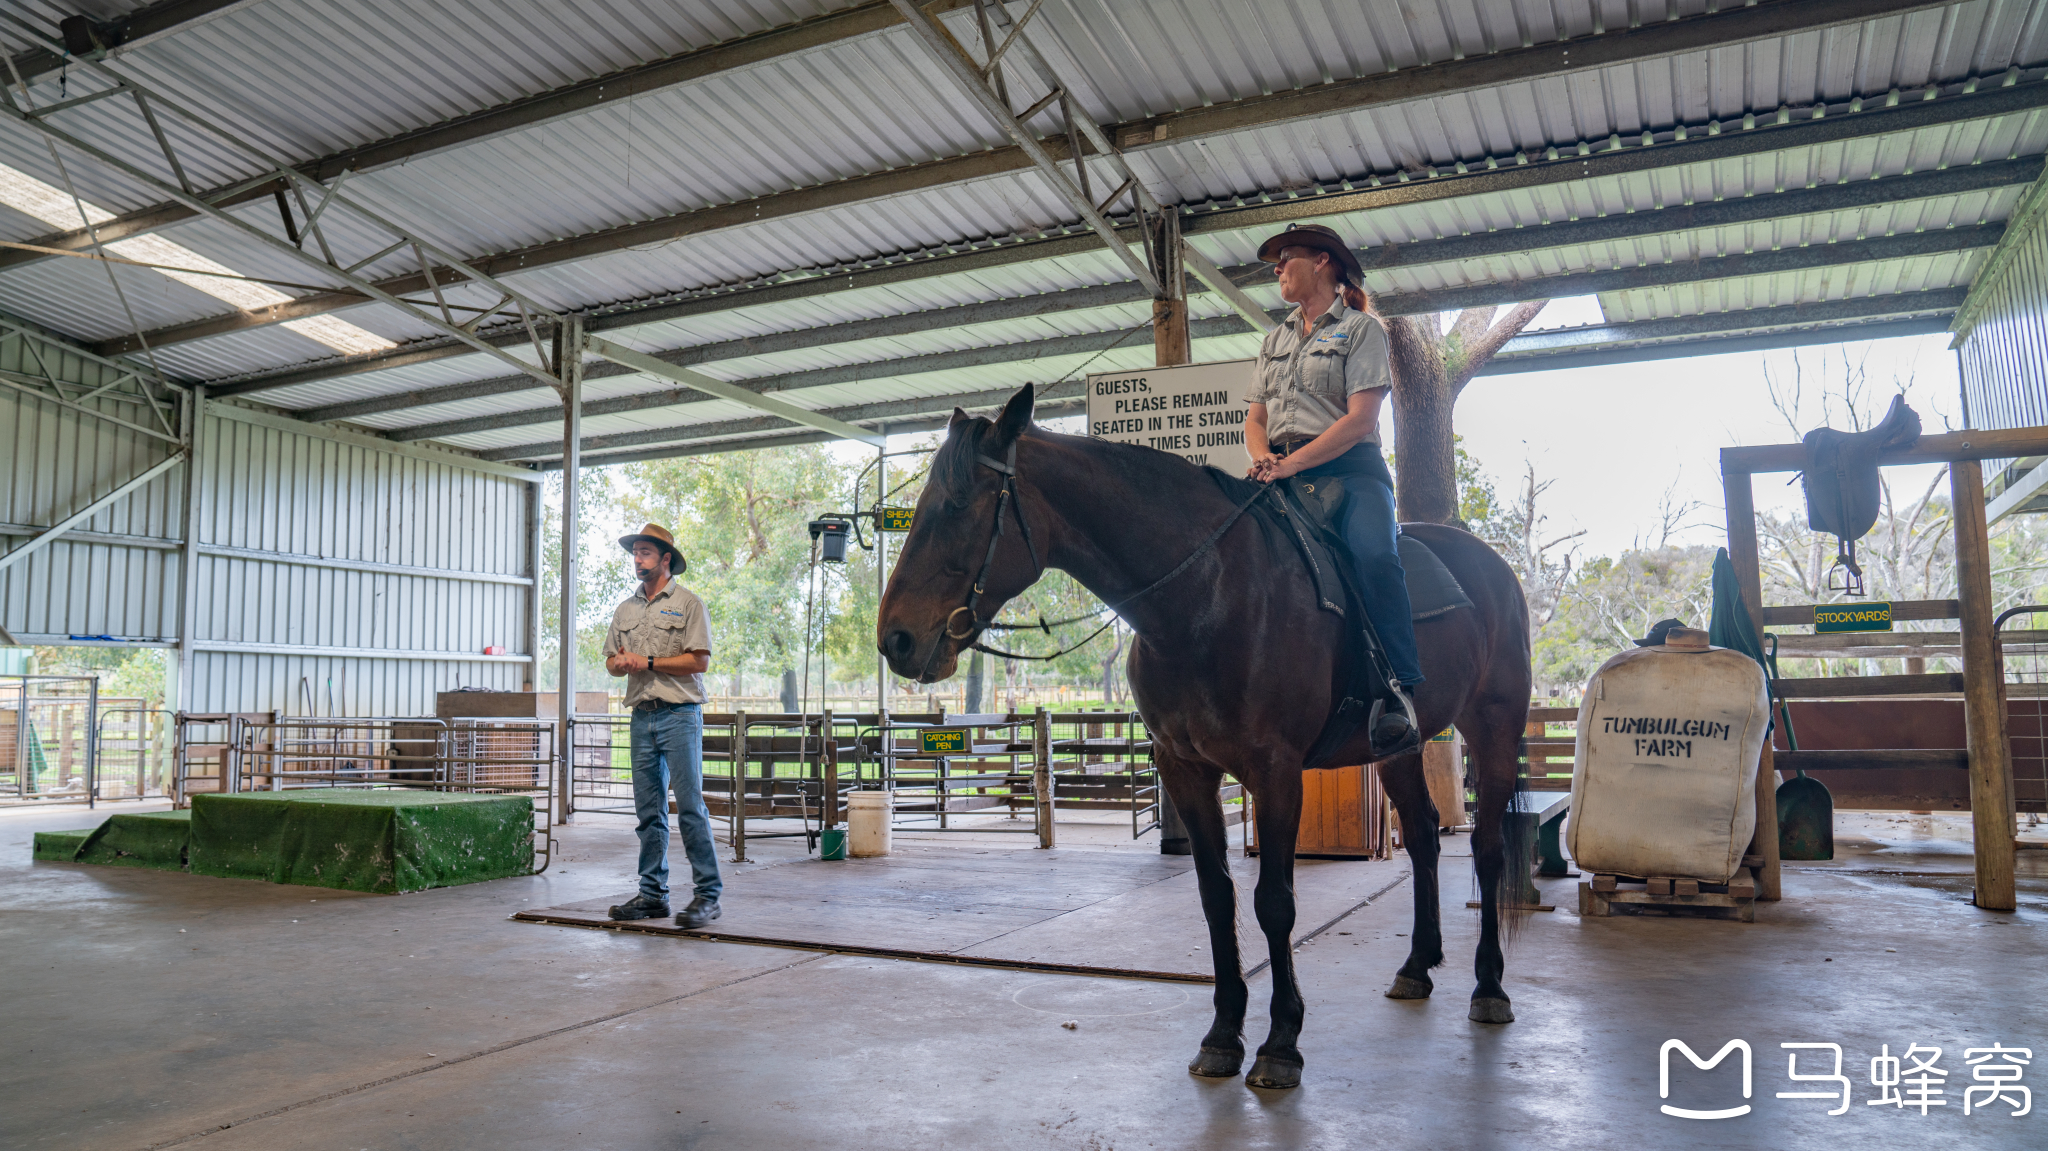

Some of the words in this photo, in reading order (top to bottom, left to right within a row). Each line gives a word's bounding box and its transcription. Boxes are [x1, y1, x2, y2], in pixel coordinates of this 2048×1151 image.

[1096, 378, 1152, 396] GUESTS,
[1115, 396, 1167, 414] PLEASE
[1173, 390, 1228, 409] REMAIN
[1093, 418, 1143, 436] SEATED
[1148, 416, 1162, 431] IN
[1167, 414, 1193, 429] THE
[1148, 434, 1191, 451] TIMES
[1816, 610, 1890, 624] STOCKYARDS
[926, 733, 961, 742] CATCHING
[1602, 717, 1730, 741] TUMBULGUM
[935, 742, 952, 750] PEN
[1635, 738, 1692, 758] FARM
